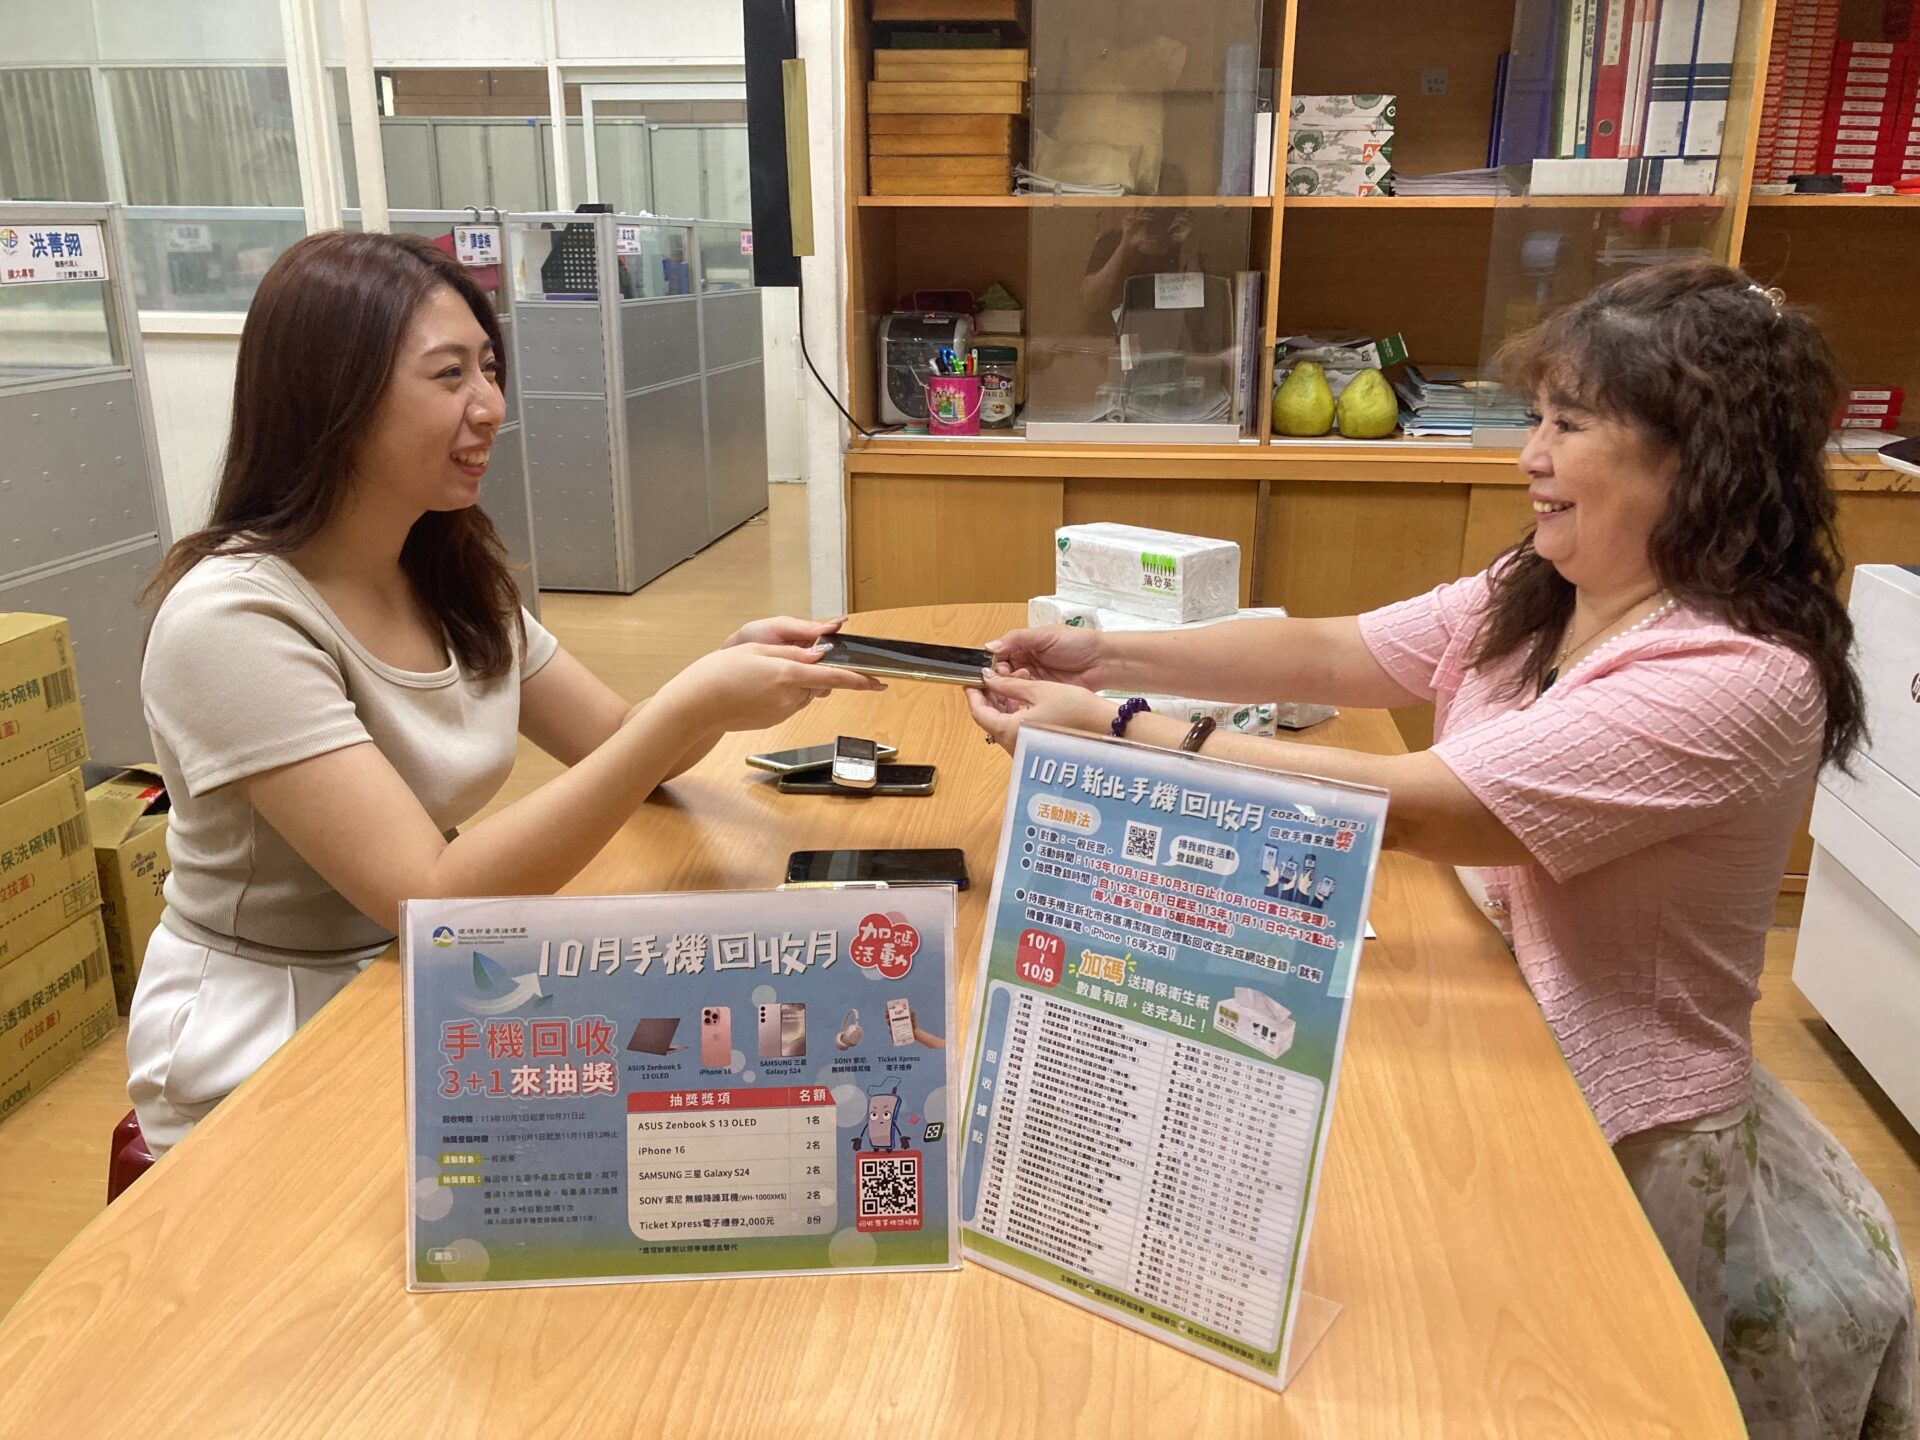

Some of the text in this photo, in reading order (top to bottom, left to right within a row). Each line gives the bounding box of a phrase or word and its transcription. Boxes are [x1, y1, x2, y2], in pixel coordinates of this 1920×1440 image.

[1143, 573, 1175, 591] 蒲公英
[1029, 755, 1266, 836] 10月新北手機回收月
[1036, 802, 1091, 828] 活動辦法
[1270, 810, 1300, 821] 2024
[1176, 851, 1214, 869] 登錄網站
[1177, 838, 1235, 860] 掃我前往活動
[861, 922, 914, 948] 加碼
[1026, 931, 1057, 953] 10/1
[538, 929, 839, 977] 10月手機回收月
[855, 943, 909, 968] 活動
[1021, 960, 1054, 983] 10/9
[1079, 950, 1126, 985] 加碼
[1127, 973, 1210, 1009] 送環保衛生紙
[444, 1020, 613, 1060] 手機回收
[444, 1062, 615, 1095] 3+1來抽獎
[669, 1092, 731, 1107] 抽獎獎項
[799, 1088, 826, 1102] 名額
[638, 1115, 821, 1130] ASUS Zenbook S 13 OLED 1名
[638, 1140, 821, 1156] iPhone 16 2名
[639, 1165, 821, 1180] SAMSUNG 三星 Galaxy S24 2名
[639, 1196, 663, 1205] SONY
[806, 1190, 821, 1200] 2名
[640, 1219, 669, 1230] Ticket
[806, 1215, 821, 1225] 8份
